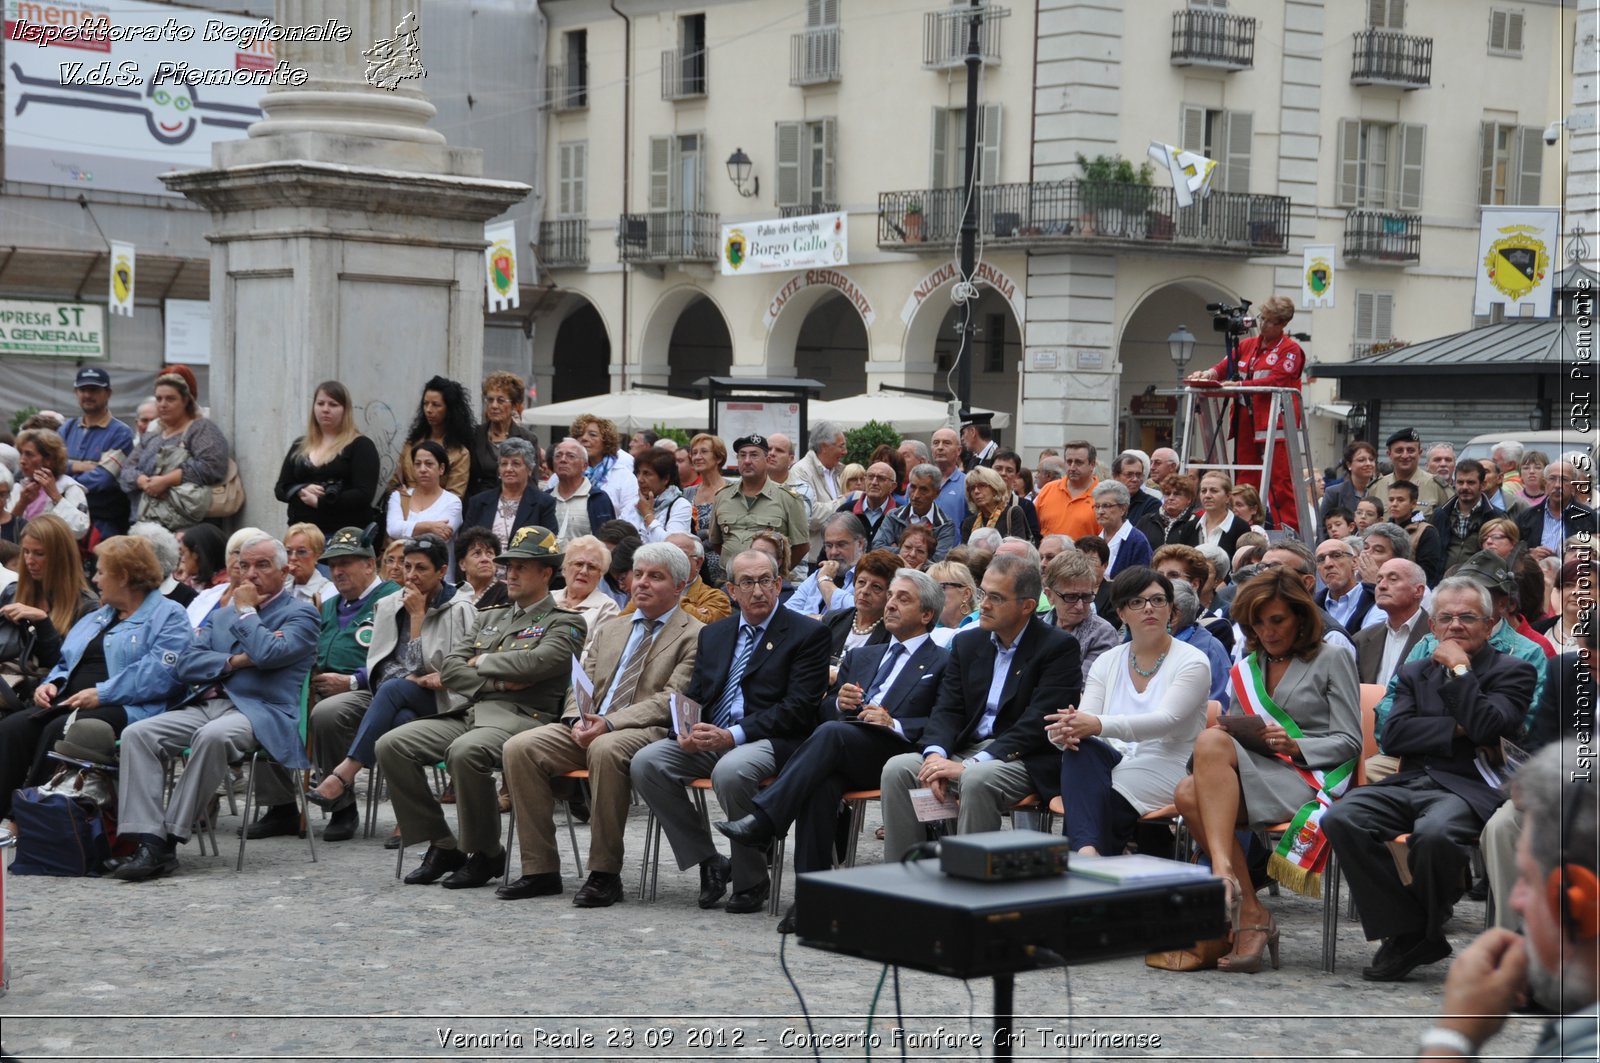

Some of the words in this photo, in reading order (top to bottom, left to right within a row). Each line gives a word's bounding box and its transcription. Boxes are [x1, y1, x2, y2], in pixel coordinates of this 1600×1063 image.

[779, 221, 791, 235] dei
[793, 219, 820, 233] Borghi
[750, 240, 789, 258] Borgo
[793, 235, 827, 252] Gallo
[805, 269, 872, 319] RISTORANTE
[914, 263, 956, 304] NUOVA
[57, 307, 84, 326] ST
[11, 329, 99, 344] GENERALE
